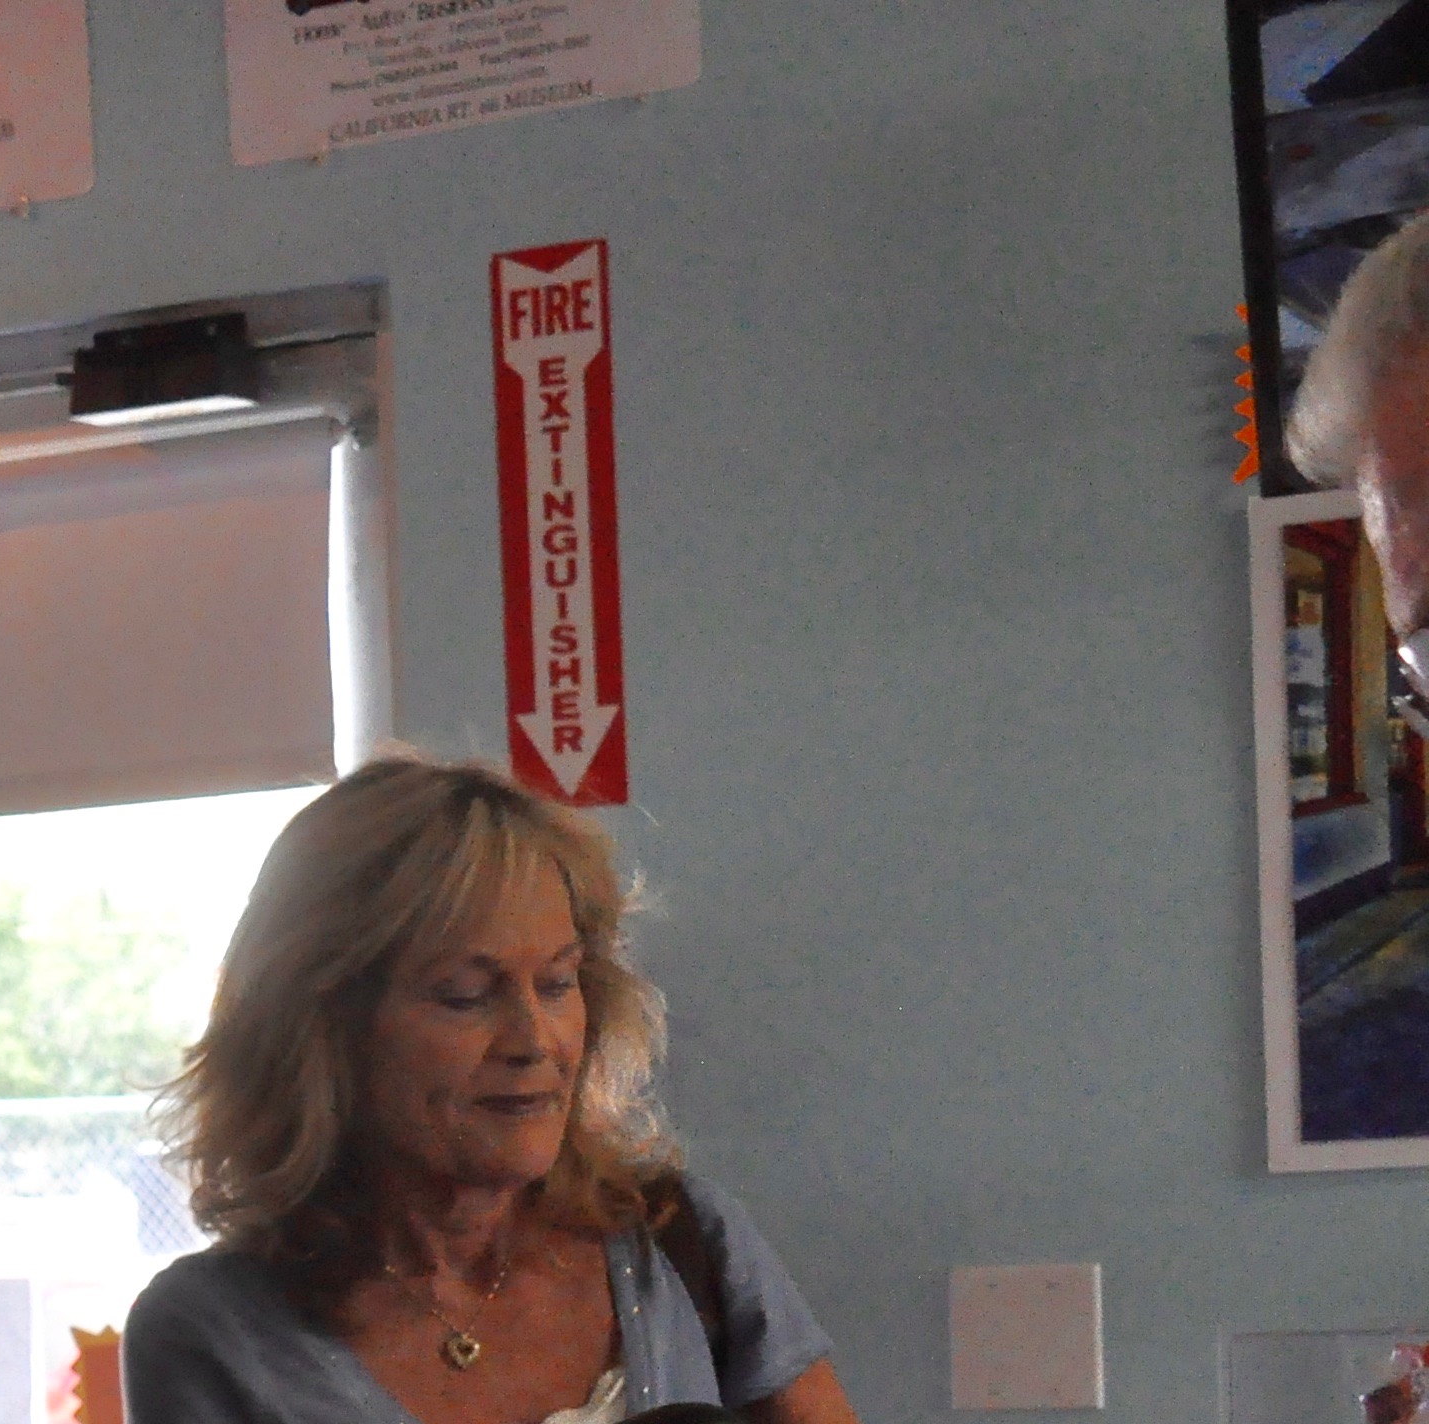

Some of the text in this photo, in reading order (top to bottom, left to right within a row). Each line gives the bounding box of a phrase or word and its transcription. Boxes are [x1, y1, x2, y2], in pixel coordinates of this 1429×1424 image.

[503, 79, 593, 110] MUSEUM
[508, 277, 595, 341] FIRE
[538, 355, 583, 755] EXTINGUISHER
